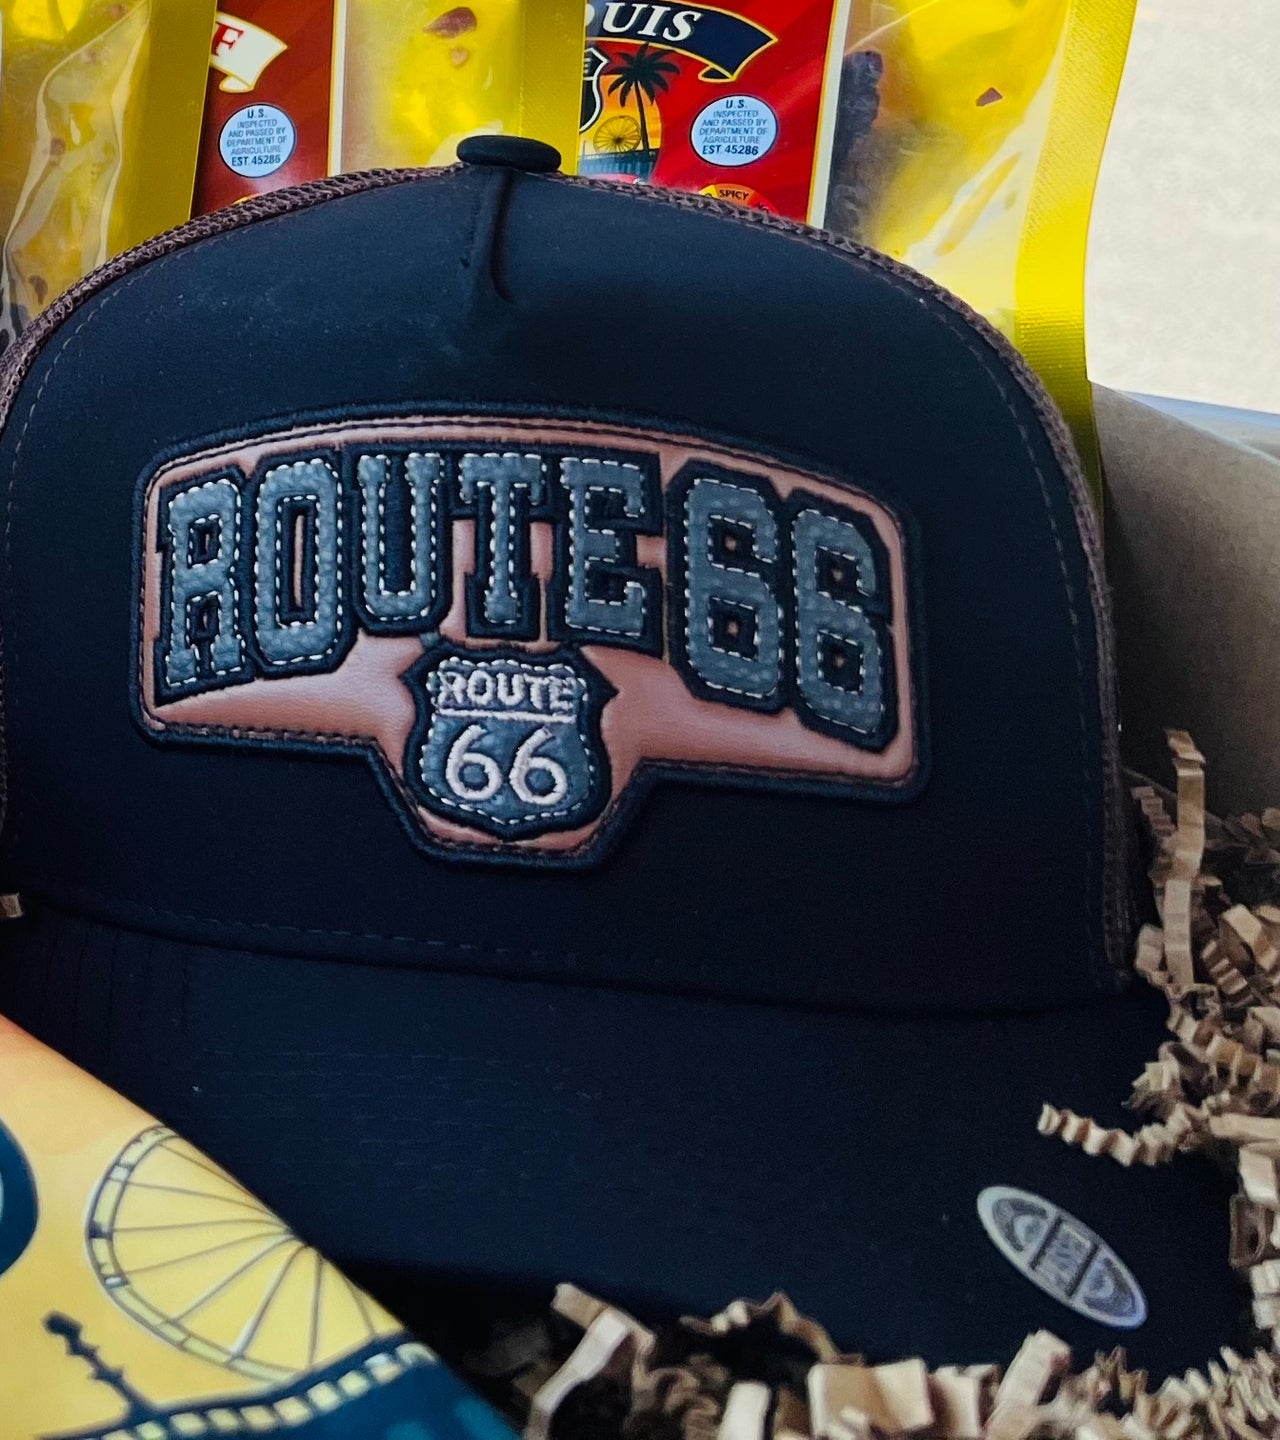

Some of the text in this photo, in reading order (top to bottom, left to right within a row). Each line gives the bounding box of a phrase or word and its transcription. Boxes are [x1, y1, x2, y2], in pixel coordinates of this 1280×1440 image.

[724, 145, 759, 155] 45286
[719, 189, 749, 198] SPICY
[438, 667, 580, 712] ROUTE
[445, 722, 570, 808] 66
